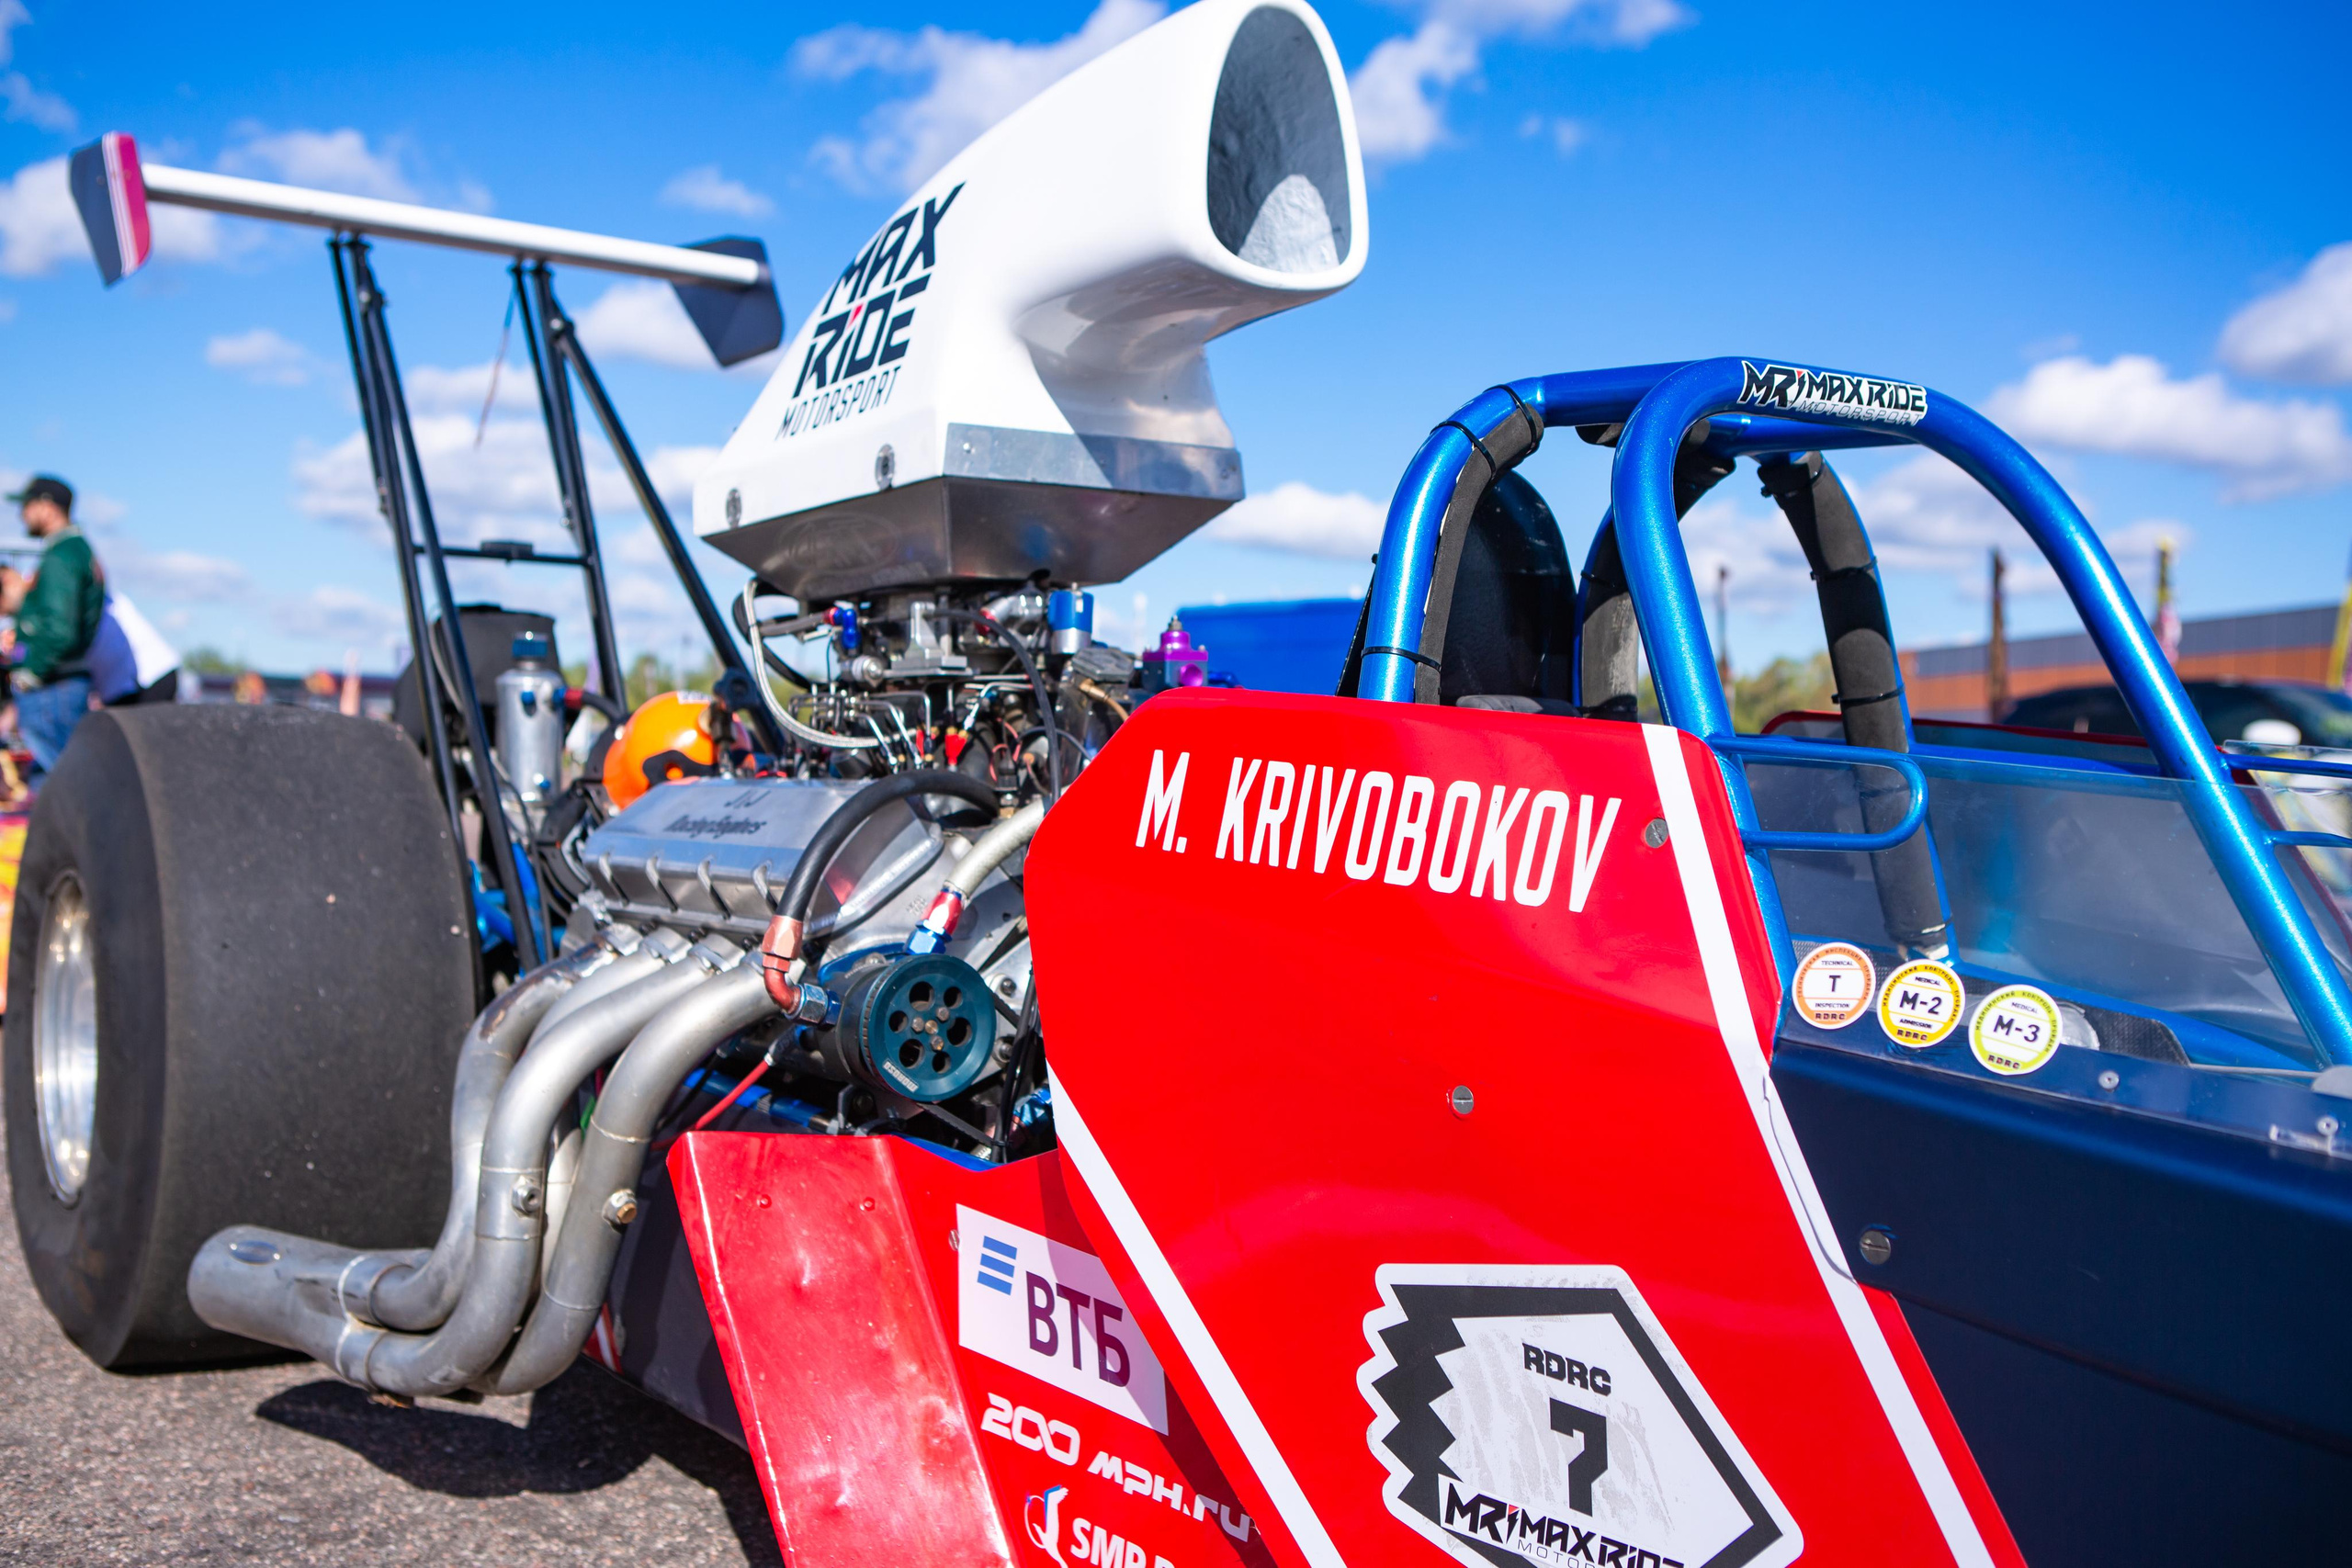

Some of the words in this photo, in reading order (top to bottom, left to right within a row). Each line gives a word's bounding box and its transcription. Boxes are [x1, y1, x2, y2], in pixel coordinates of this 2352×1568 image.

[820, 181, 967, 316] MAX
[775, 366, 900, 441] MOTORSPORT
[1798, 400, 1923, 425] MOTORSPORT
[1136, 750, 1190, 853] M.
[1215, 757, 1622, 913] KRIVOBOKOV
[1915, 976, 1940, 986] MEDICAL
[1899, 990, 1942, 1015] M-2
[2011, 1002, 2038, 1013] MEDICAL
[1896, 1029, 1928, 1041] RDRC
[1899, 1018, 1932, 1029] ADMISSION
[1993, 1014, 2041, 1043] M-3
[1987, 1055, 2020, 1069] RDRC
[1025, 1270, 1131, 1388] ВТБ
[1521, 1342, 1611, 1397] RDRC
[980, 1393, 1080, 1466] 200
[1549, 1397, 1609, 1517] 7
[1069, 1517, 1147, 1568] SMP
